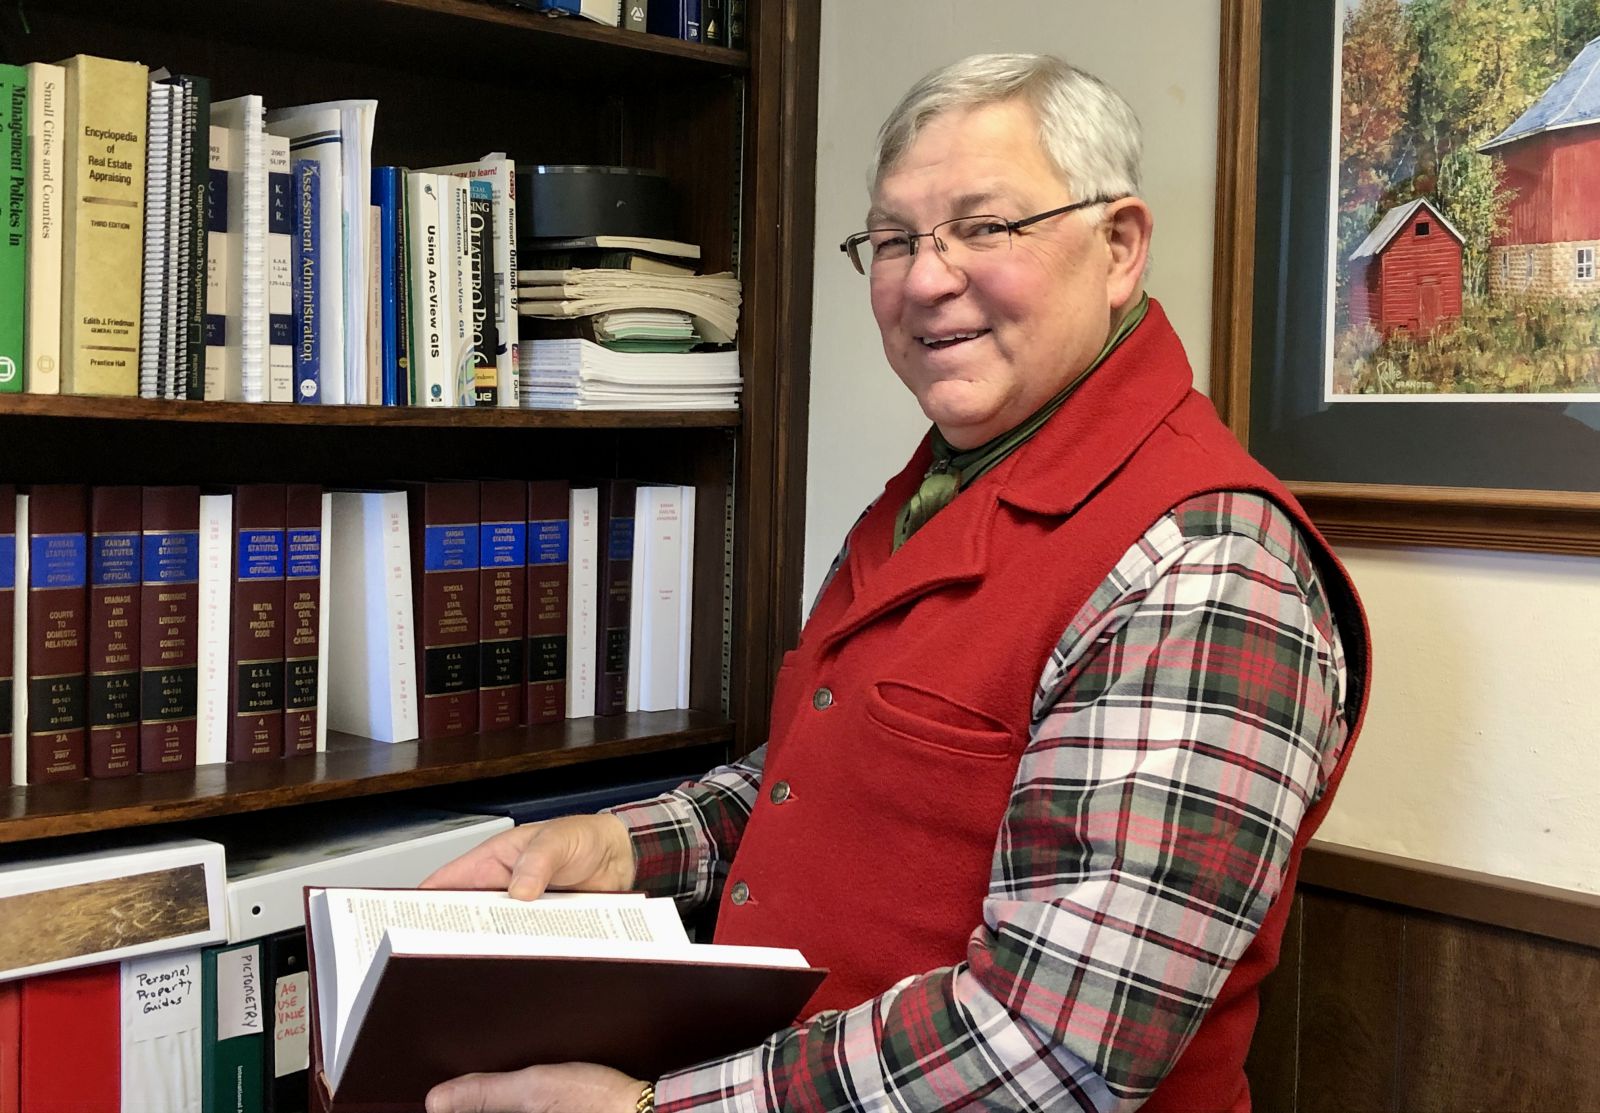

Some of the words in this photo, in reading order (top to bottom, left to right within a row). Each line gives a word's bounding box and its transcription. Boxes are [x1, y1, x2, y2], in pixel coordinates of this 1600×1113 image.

[43, 82, 55, 117] Small
[8, 84, 25, 171] Management
[43, 120, 55, 156] Cities
[85, 126, 138, 142] Encyclopedia
[106, 144, 115, 154] of
[88, 155, 106, 167] Real
[107, 158, 132, 170] Estate
[43, 158, 54, 181] and
[469, 169, 477, 178] to
[477, 166, 498, 177] learn!
[89, 169, 132, 186] Appraising
[508, 170, 516, 201] easy
[9, 175, 24, 227] Policies
[196, 184, 205, 227] Complete
[470, 201, 490, 213] ING
[42, 184, 54, 239] Counties
[302, 166, 313, 253] Assessment
[91, 220, 107, 228] THIRD
[108, 221, 130, 230] EDITION
[196, 229, 204, 256] Guide
[426, 225, 437, 265] Using
[509, 249, 518, 290] Outlook
[428, 269, 438, 329] ArcView
[303, 257, 315, 362] Administration
[83, 317, 100, 325] Edith
[107, 318, 135, 327] Friedman
[430, 333, 440, 358] GIS
[105, 539, 130, 547] KANSAS
[101, 548, 133, 557] STATUTES
[249, 566, 276, 574] OFFICIAL
[291, 565, 318, 573] OFFICIAL
[103, 572, 132, 580] OFFICIAL
[443, 584, 464, 592] SCHOOLS
[169, 604, 177, 612] TO
[446, 601, 460, 609] STATE
[49, 610, 74, 619] COURTS
[112, 607, 123, 616] AND
[258, 612, 267, 620] TO
[298, 610, 312, 618] CIVIL
[57, 620, 66, 628] TO
[249, 620, 275, 629] PROBATE
[301, 618, 309, 627] TO
[46, 630, 76, 639] DOMESTIC
[114, 631, 122, 639] TO
[167, 627, 179, 636] AND
[254, 630, 270, 638] CODE
[45, 639, 78, 649] RELATIONS
[108, 642, 127, 651] SOCIAL
[105, 654, 130, 663] WELFARE
[55, 734, 68, 743] 2A
[136, 964, 190, 987] Personal
[136, 978, 192, 1001] Property
[241, 954, 258, 1028] PICTOMETRY
[280, 983, 297, 998] AG
[143, 996, 182, 1014] Guides
[277, 997, 298, 1010] USE
[278, 1007, 305, 1024] VALUE
[276, 1024, 306, 1040] CALCS
